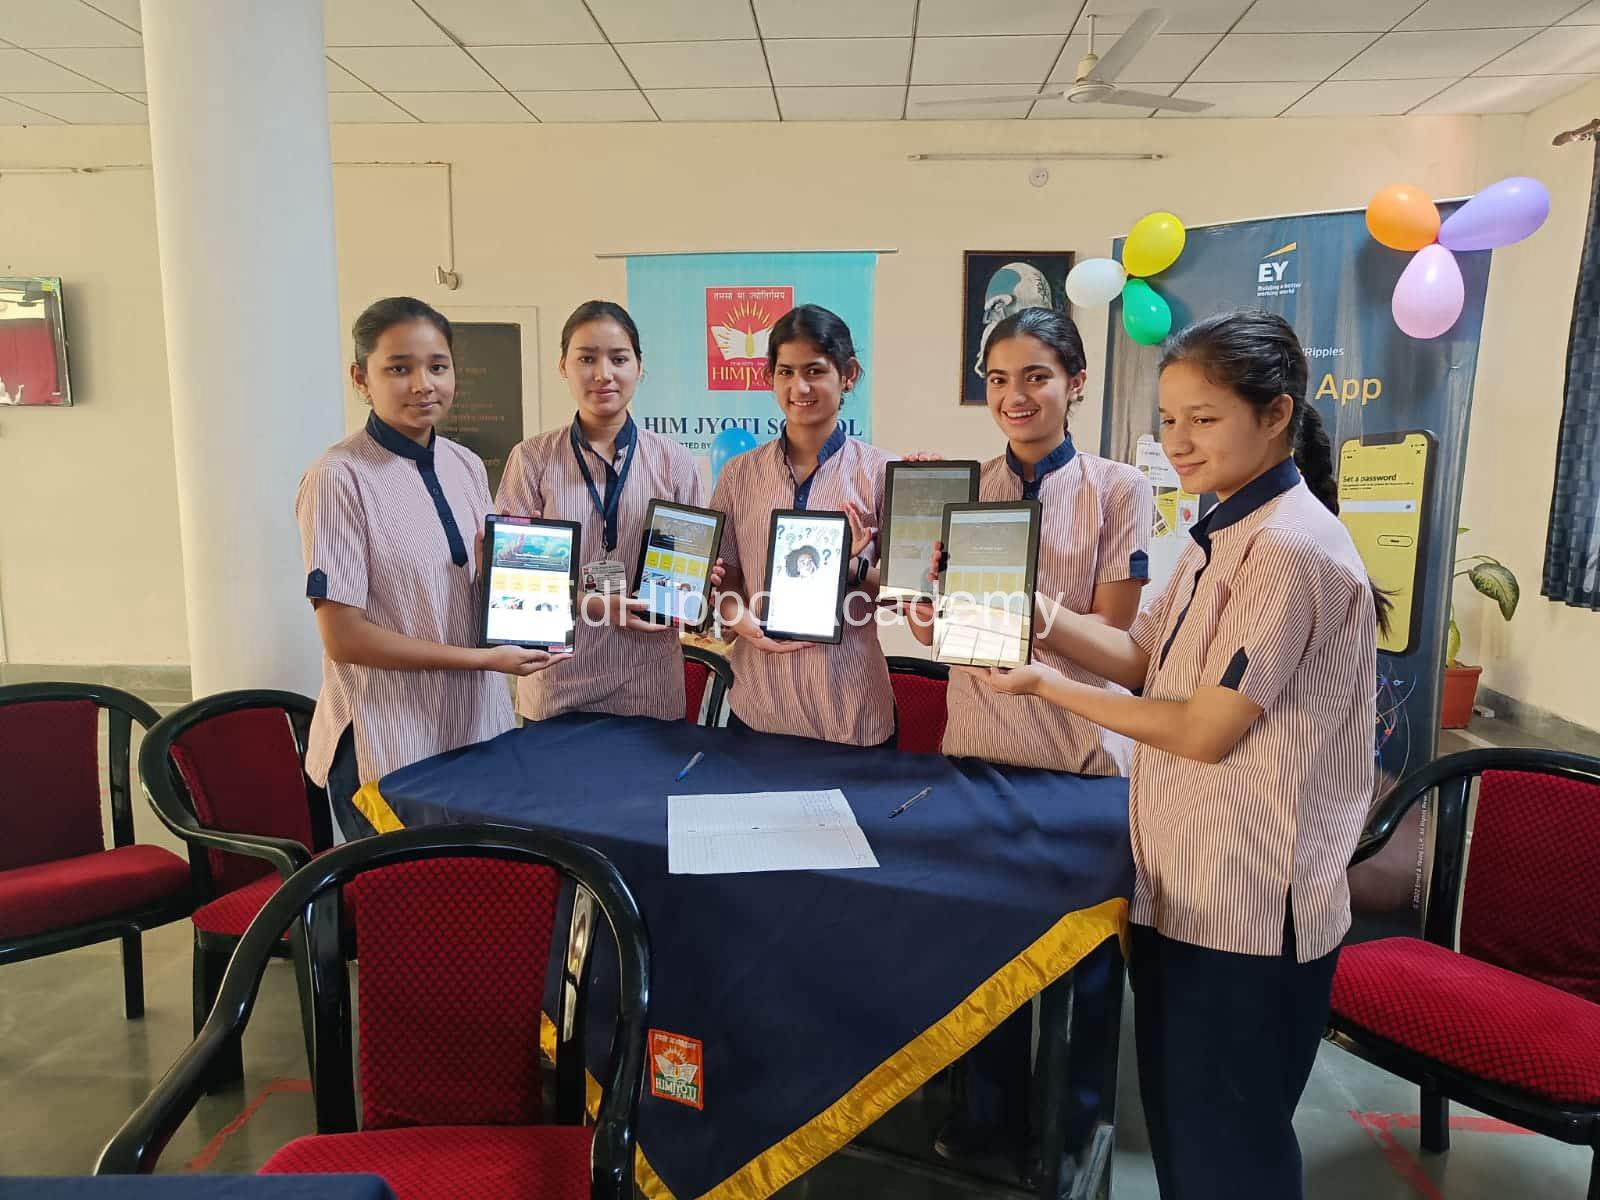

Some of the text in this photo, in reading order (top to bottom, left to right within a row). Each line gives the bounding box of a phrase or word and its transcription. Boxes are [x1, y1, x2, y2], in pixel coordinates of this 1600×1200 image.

[1258, 260, 1289, 282] EY
[1303, 346, 1344, 358] Ripples
[1314, 373, 1383, 407] App
[644, 417, 687, 434] HIM
[694, 417, 760, 434] JYOTI
[1361, 474, 1397, 483] password
